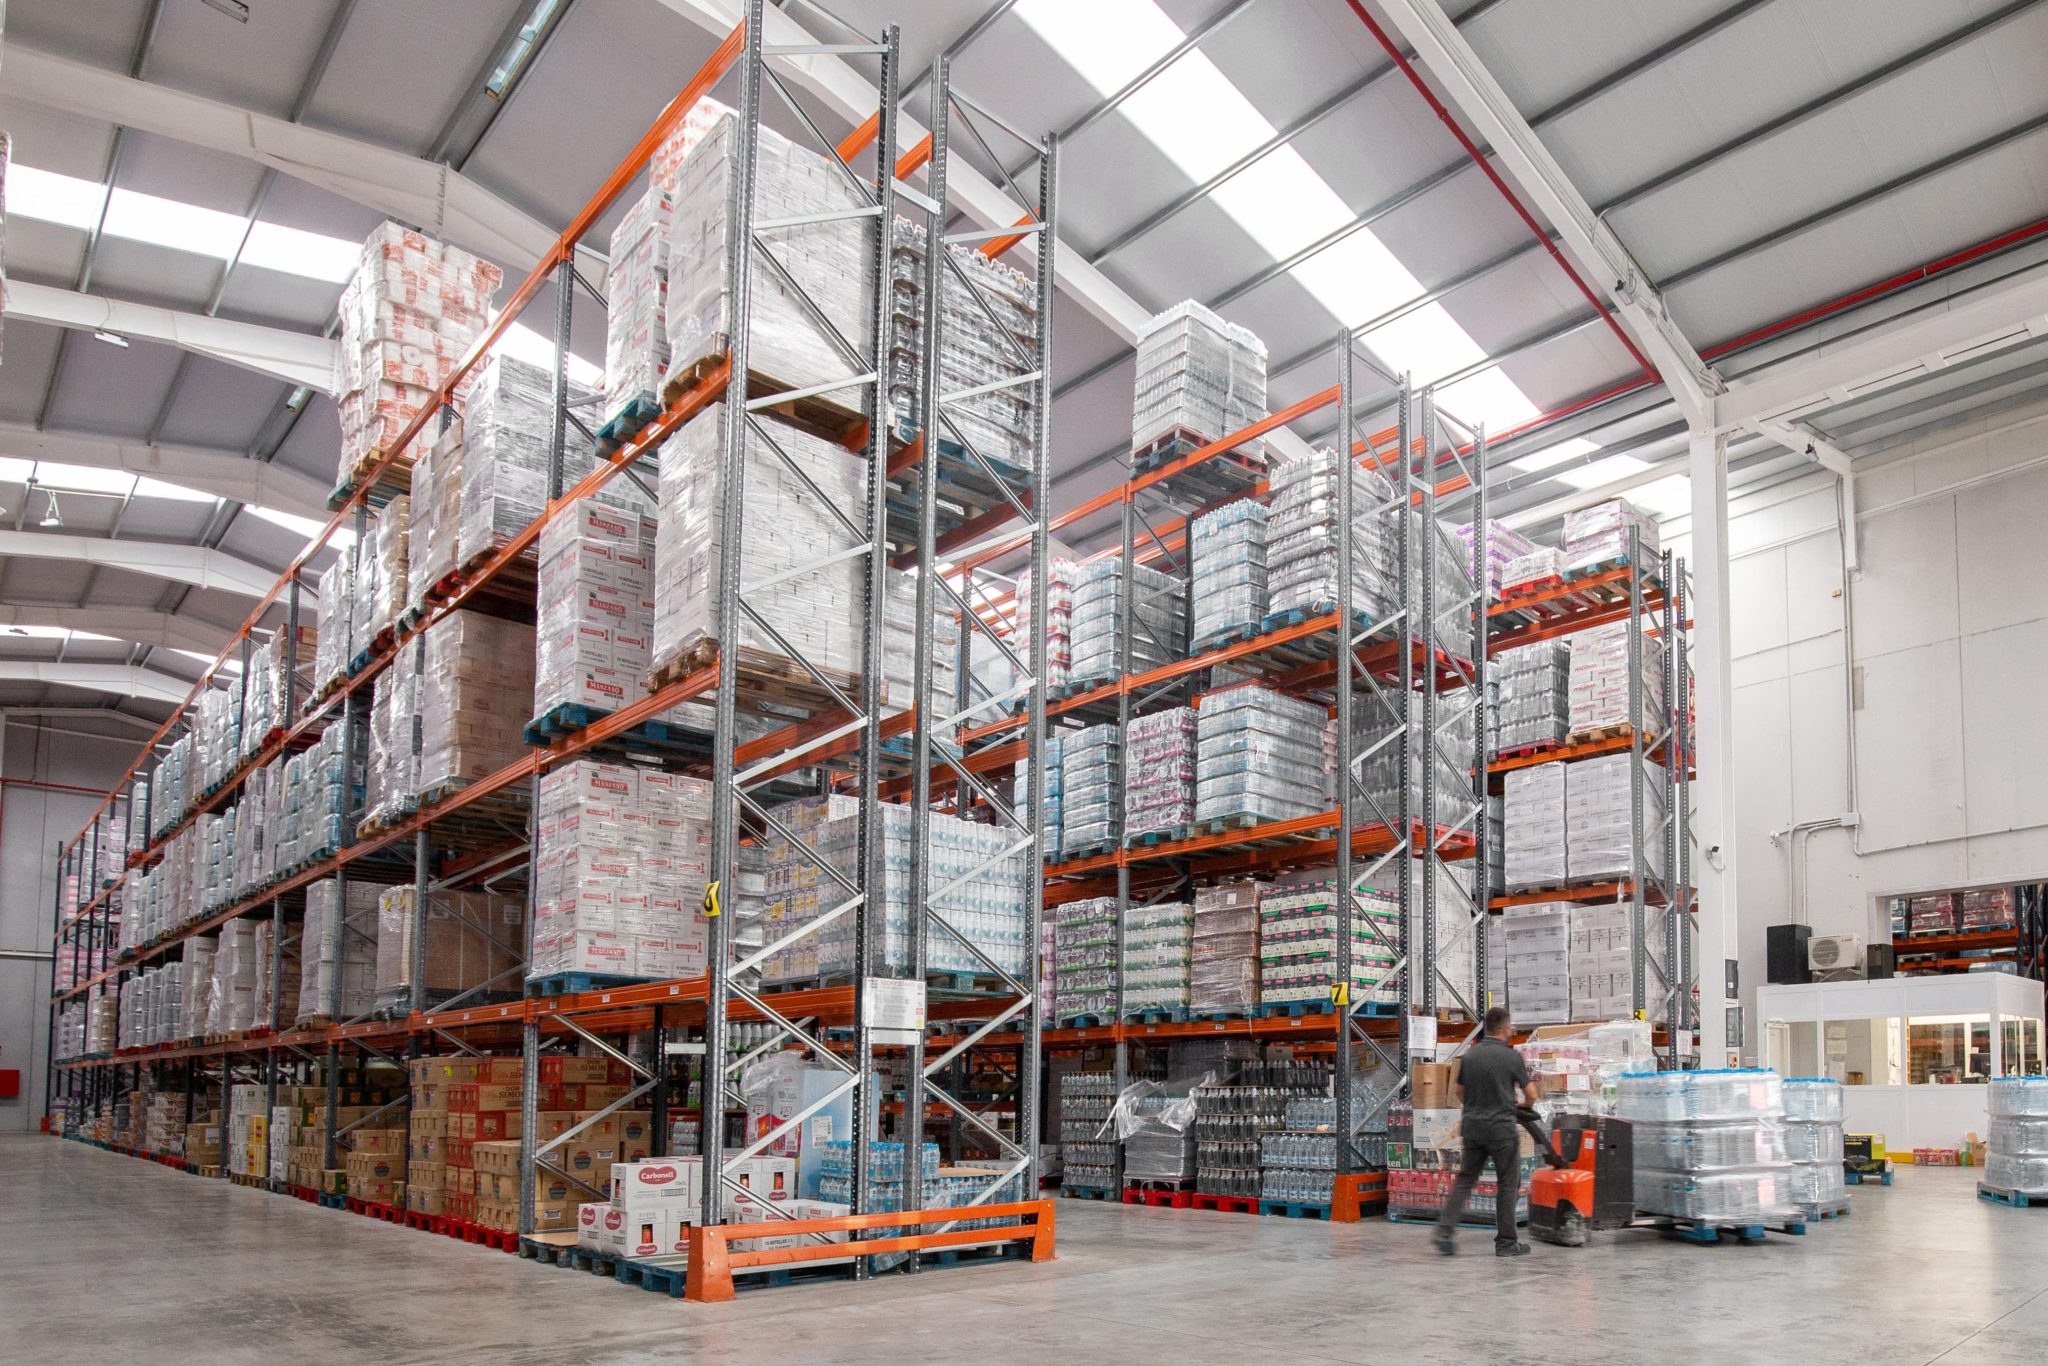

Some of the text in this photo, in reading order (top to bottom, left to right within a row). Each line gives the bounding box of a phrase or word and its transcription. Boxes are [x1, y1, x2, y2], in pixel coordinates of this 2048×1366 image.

[592, 600, 622, 612] MANZANO
[590, 682, 620, 693] MANZANO
[594, 780, 625, 790] MANZANO
[704, 884, 714, 912] 6
[1332, 984, 1343, 1003] 7
[641, 1171, 674, 1179] Carbonell
